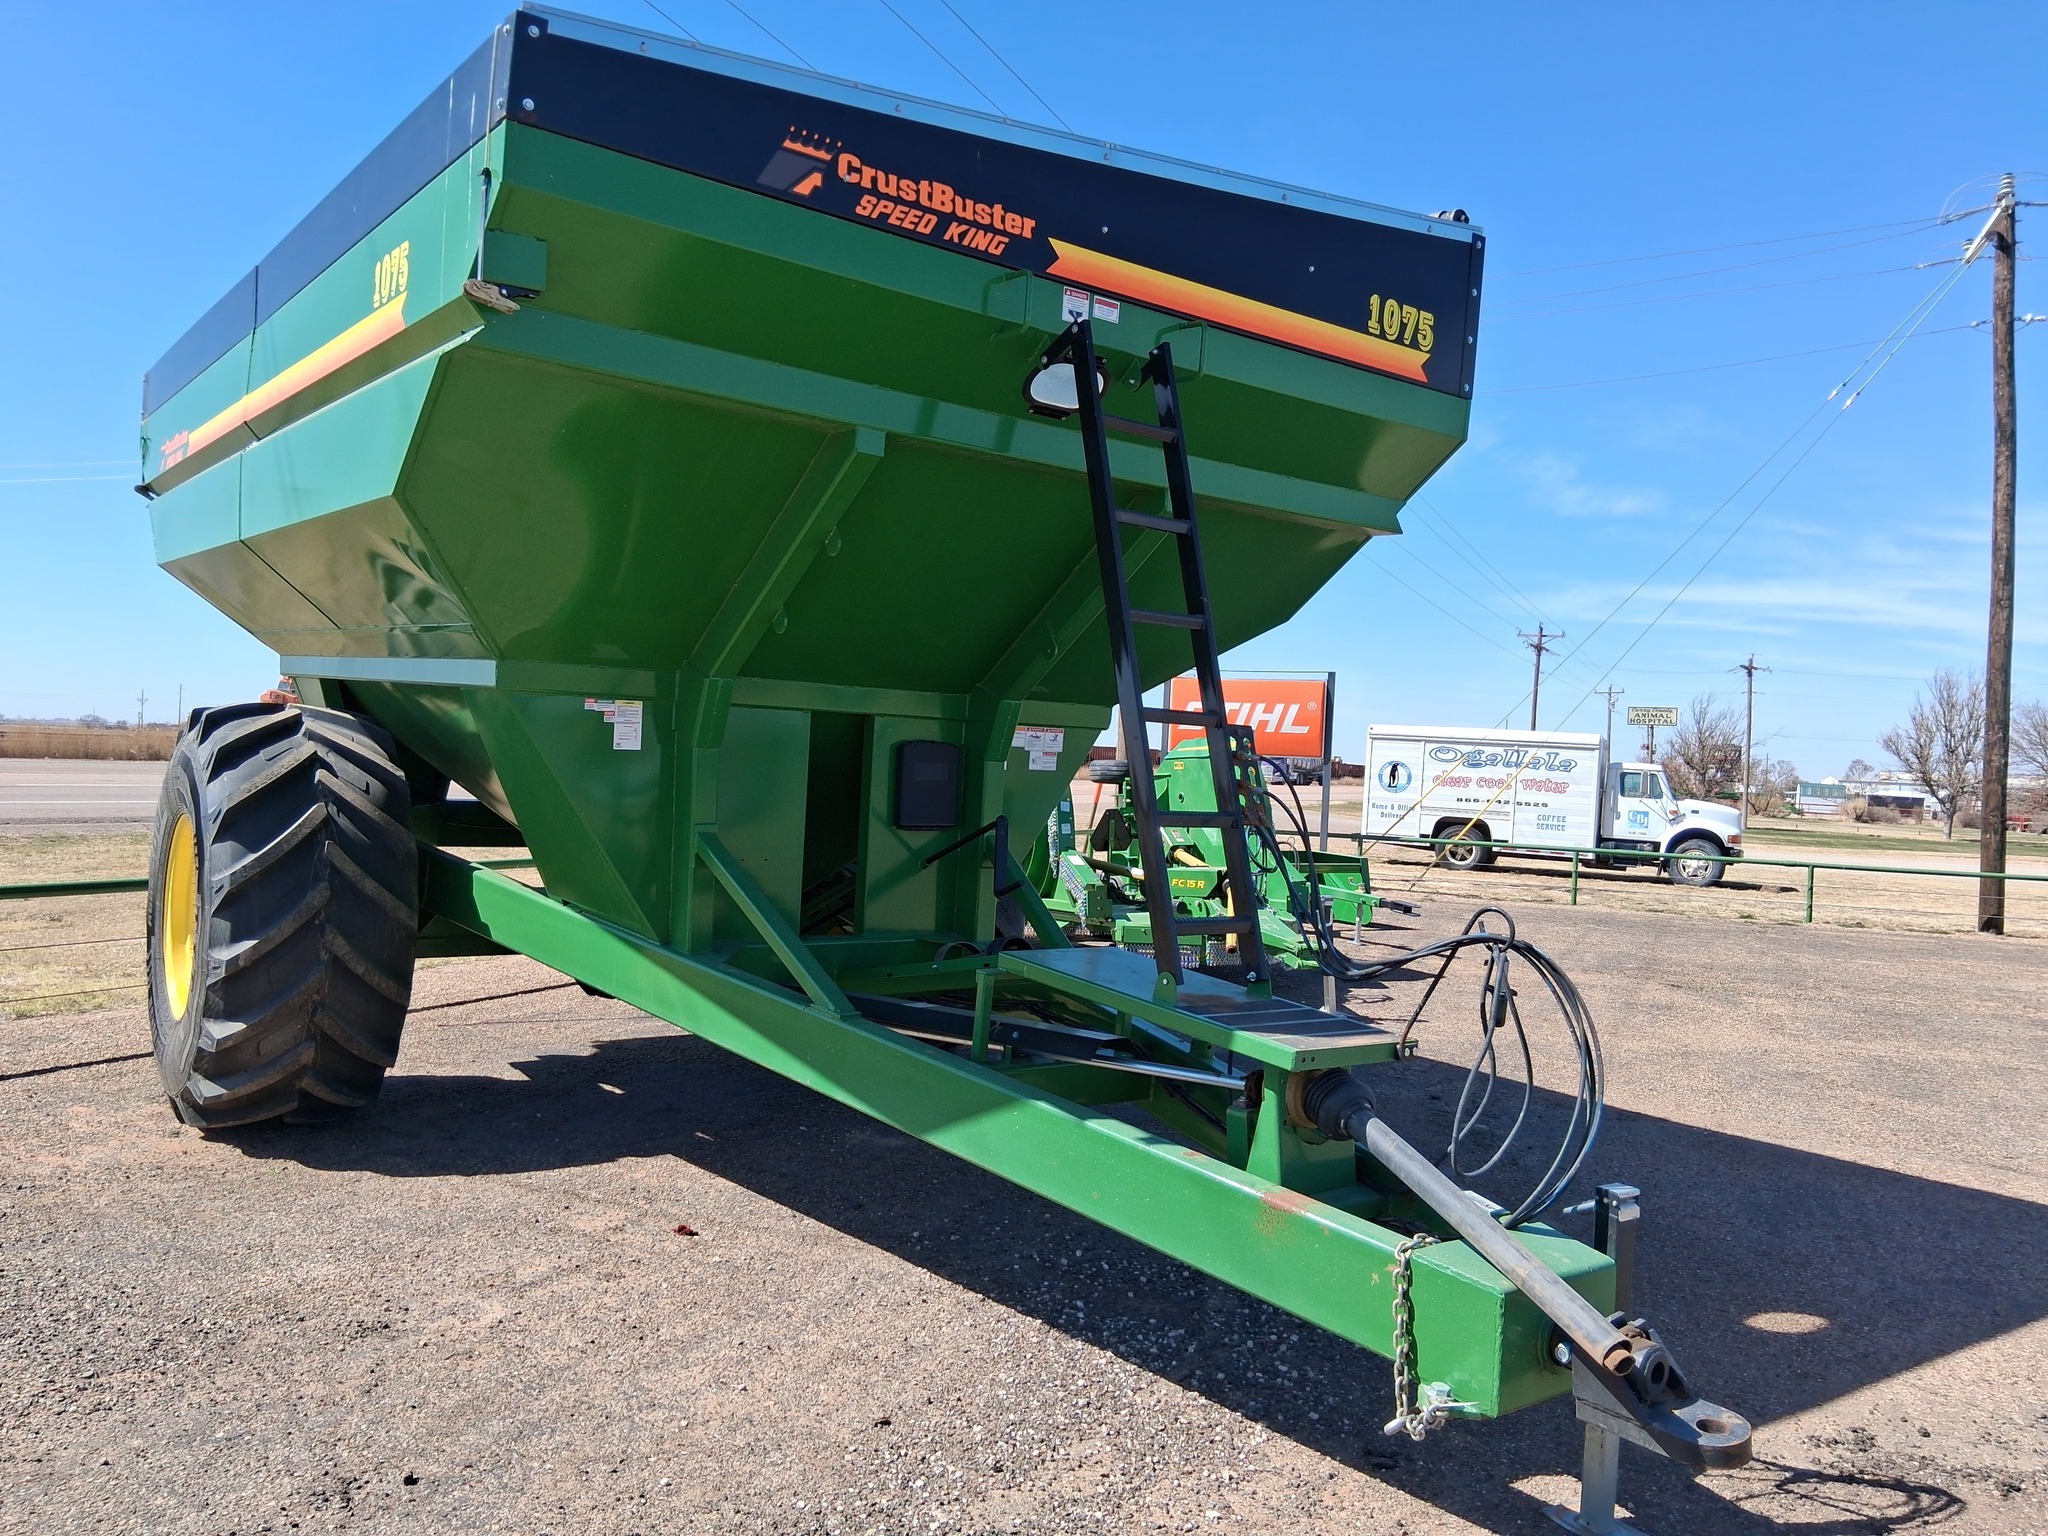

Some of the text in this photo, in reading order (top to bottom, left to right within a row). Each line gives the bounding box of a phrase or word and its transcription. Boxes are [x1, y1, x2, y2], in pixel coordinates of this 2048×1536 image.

[837, 153, 1036, 239] CrustBuster
[855, 194, 1010, 256] SPEED KING
[372, 240, 410, 309] 1075
[1367, 293, 1435, 352] 1075
[1429, 746, 1578, 773] Ogallala
[1432, 770, 1473, 789] clear
[1476, 773, 1513, 790] cool
[1520, 778, 1570, 794] water
[1371, 802, 1389, 810] Home
[1537, 814, 1567, 823] COFFEE
[1536, 822, 1566, 832] SERVICE
[1171, 878, 1205, 889] FC 15 R
